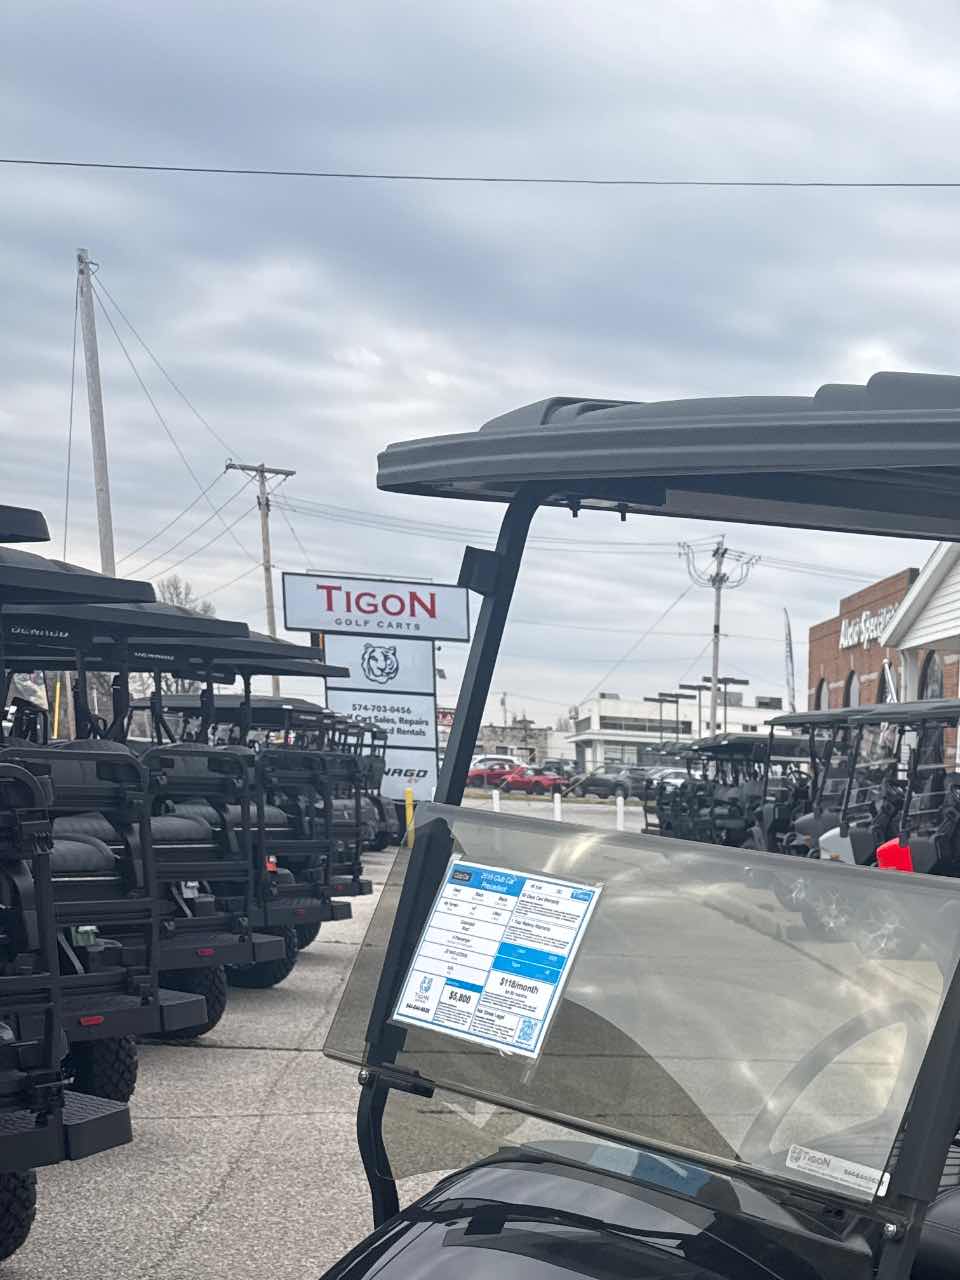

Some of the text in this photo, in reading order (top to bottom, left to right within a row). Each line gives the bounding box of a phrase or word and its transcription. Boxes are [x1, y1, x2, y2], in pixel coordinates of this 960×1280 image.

[316, 584, 437, 618] TIGON
[335, 618, 420, 631] GOLF CARTS
[352, 704, 412, 714] 574-703-0456
[399, 717, 429, 726] Repairs
[397, 728, 427, 736] Rentals
